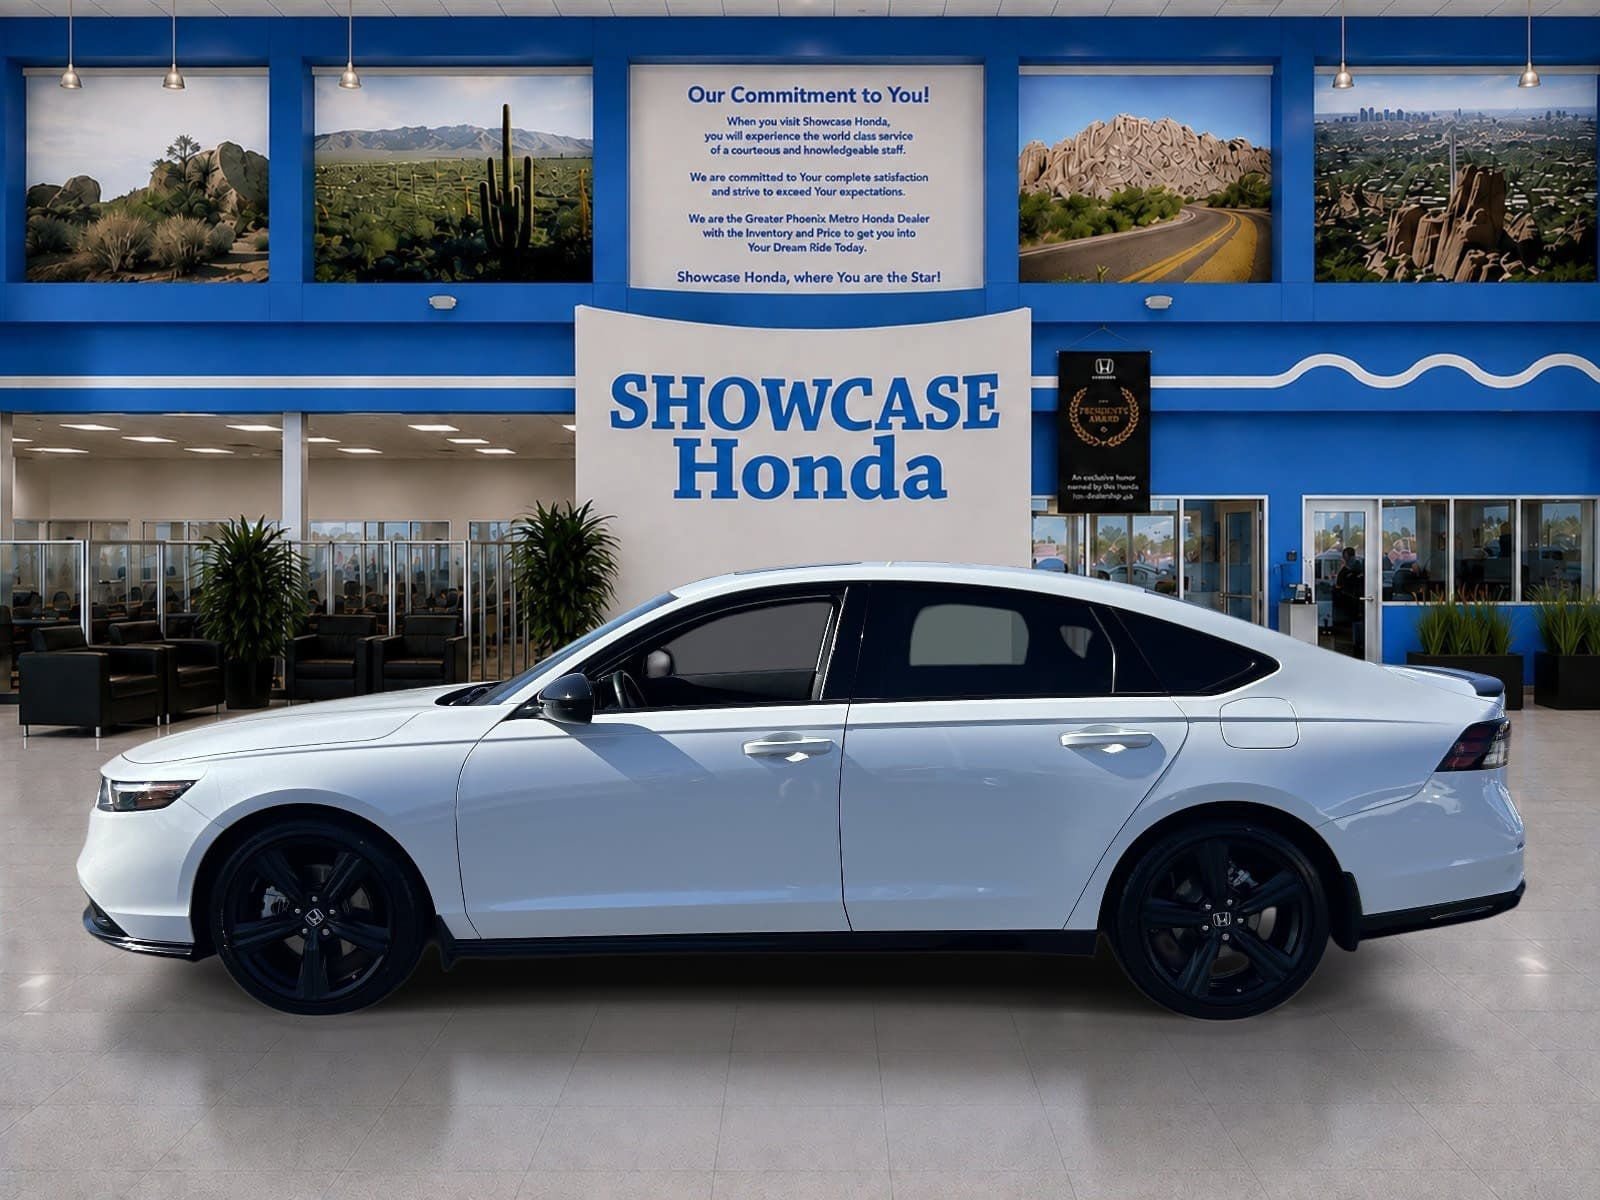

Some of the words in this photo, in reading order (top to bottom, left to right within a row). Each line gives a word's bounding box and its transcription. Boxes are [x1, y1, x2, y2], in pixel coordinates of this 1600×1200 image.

[687, 85, 726, 104] Our
[730, 85, 857, 104] Commitment
[861, 87, 883, 104] to
[886, 85, 930, 104] You!
[726, 116, 757, 127] When
[758, 118, 778, 129] you
[779, 116, 801, 127] visit
[802, 115, 853, 127] Showcase
[854, 116, 891, 128] Honda,
[704, 133, 724, 144] you
[725, 130, 743, 141] will
[745, 130, 801, 144] experience
[802, 130, 820, 141] the
[821, 130, 851, 141] world
[852, 130, 877, 141] class
[878, 130, 914, 142] service
[730, 146, 781, 156] courteous
[782, 144, 802, 155] and
[881, 144, 907, 155] staff.
[689, 172, 708, 182] We
[709, 174, 726, 182] are
[728, 171, 784, 183] committed
[785, 173, 798, 183] to
[799, 172, 823, 183] Your
[824, 171, 872, 185] complete
[873, 171, 929, 183] satisfaction
[711, 185, 731, 197] and
[732, 186, 761, 197] strive
[762, 187, 774, 197] to
[775, 186, 812, 197] exceed
[813, 186, 838, 197] Your
[839, 186, 906, 200] expectations.
[688, 213, 706, 224] We
[707, 215, 725, 224] are
[725, 213, 743, 224] the
[744, 213, 784, 224] Greater
[785, 213, 827, 224] Phoenix
[828, 213, 860, 224] Metro
[861, 213, 895, 224] Honda
[897, 213, 931, 224] Dealer
[702, 227, 725, 238] with
[726, 227, 744, 238] the
[745, 227, 794, 241] Inventory
[795, 227, 815, 238] and
[816, 227, 842, 238] Price
[843, 229, 855, 238] to
[856, 229, 875, 241] get
[875, 230, 895, 241] you
[896, 227, 917, 238] into
[747, 242, 772, 253] Your
[773, 242, 808, 253] Dream
[809, 242, 833, 253] Ride
[834, 242, 868, 255] Today.
[677, 270, 741, 284] Showcase
[744, 270, 790, 286] Honda,
[793, 270, 834, 284] where
[836, 271, 861, 284] You
[863, 274, 884, 284] are
[886, 270, 908, 284] the
[910, 270, 941, 284] Star!
[610, 372, 1000, 432] SHOWCASE
[672, 434, 948, 501] Honda
